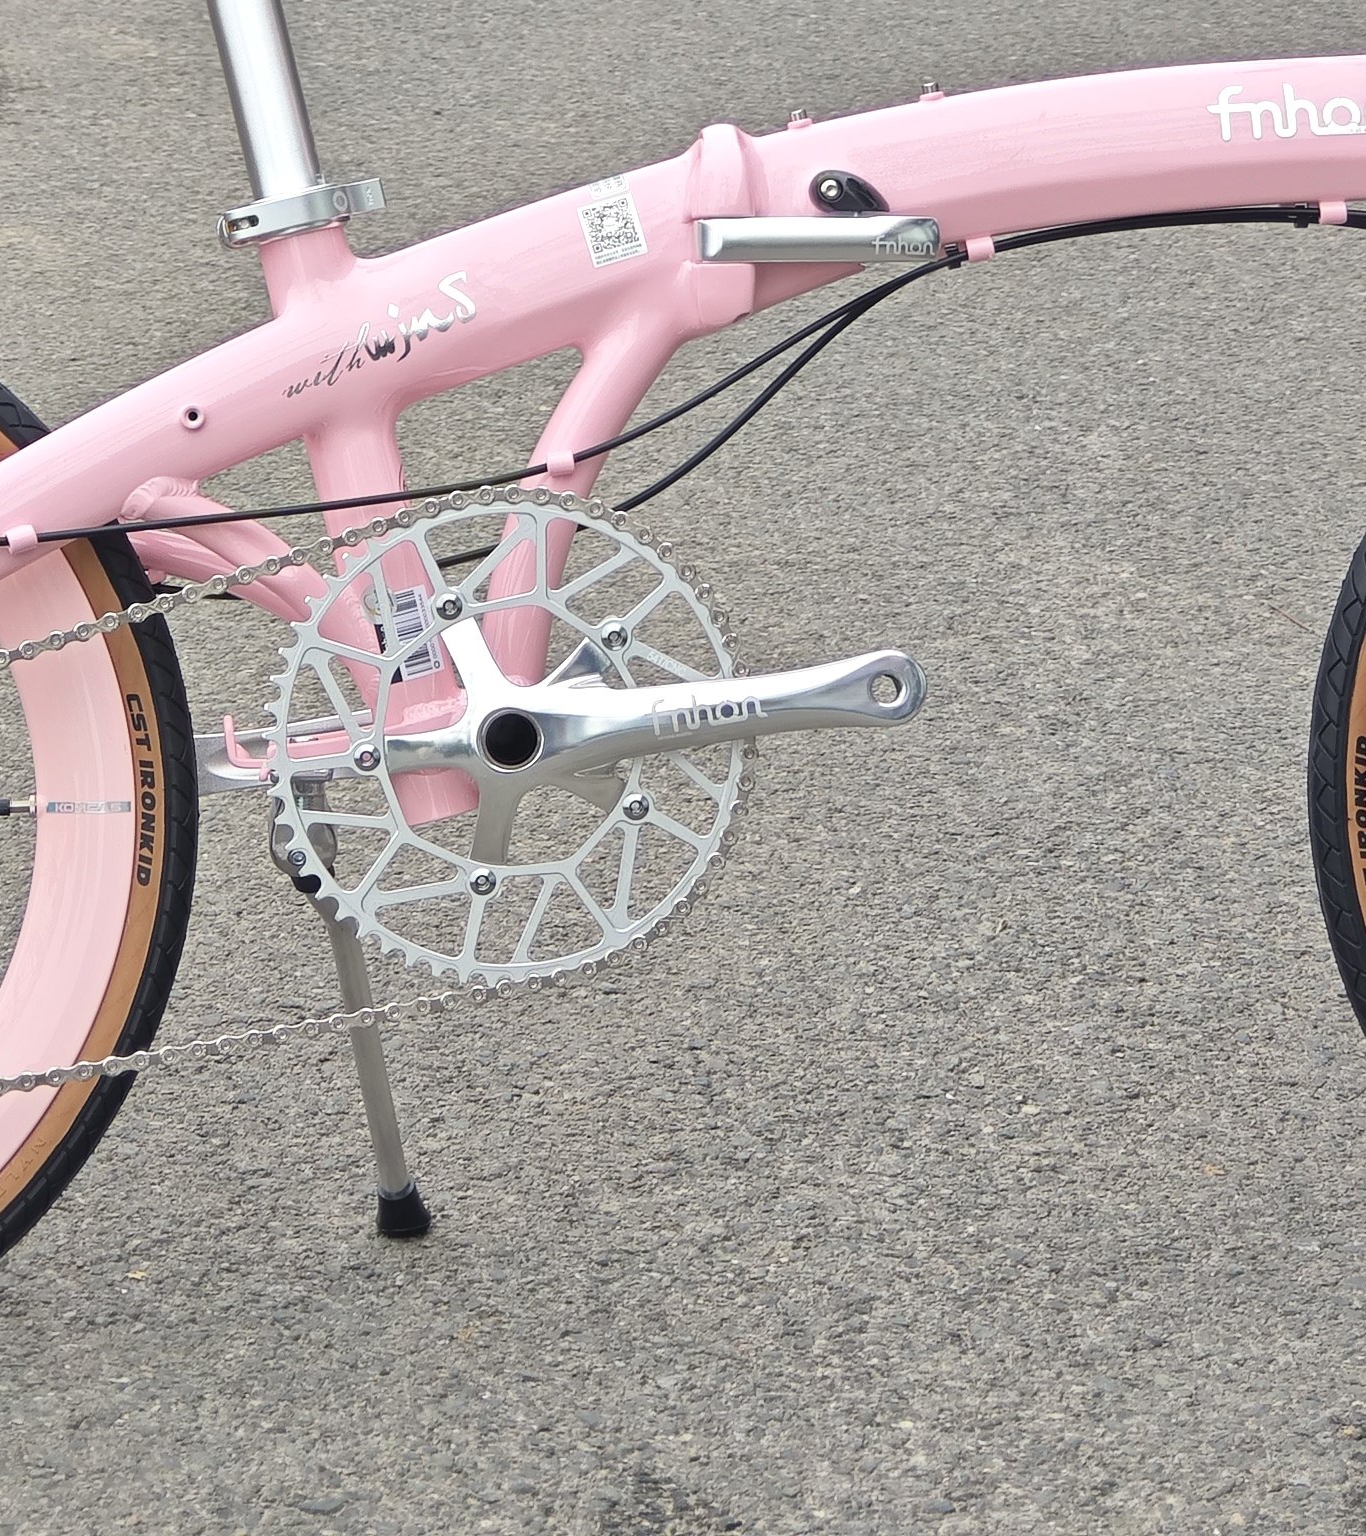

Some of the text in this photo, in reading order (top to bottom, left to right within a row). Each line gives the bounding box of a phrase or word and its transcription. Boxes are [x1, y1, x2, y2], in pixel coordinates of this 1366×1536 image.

[871, 233, 936, 255] fnhon
[643, 694, 769, 736] fnhon
[125, 693, 156, 887] CST IRONKID
